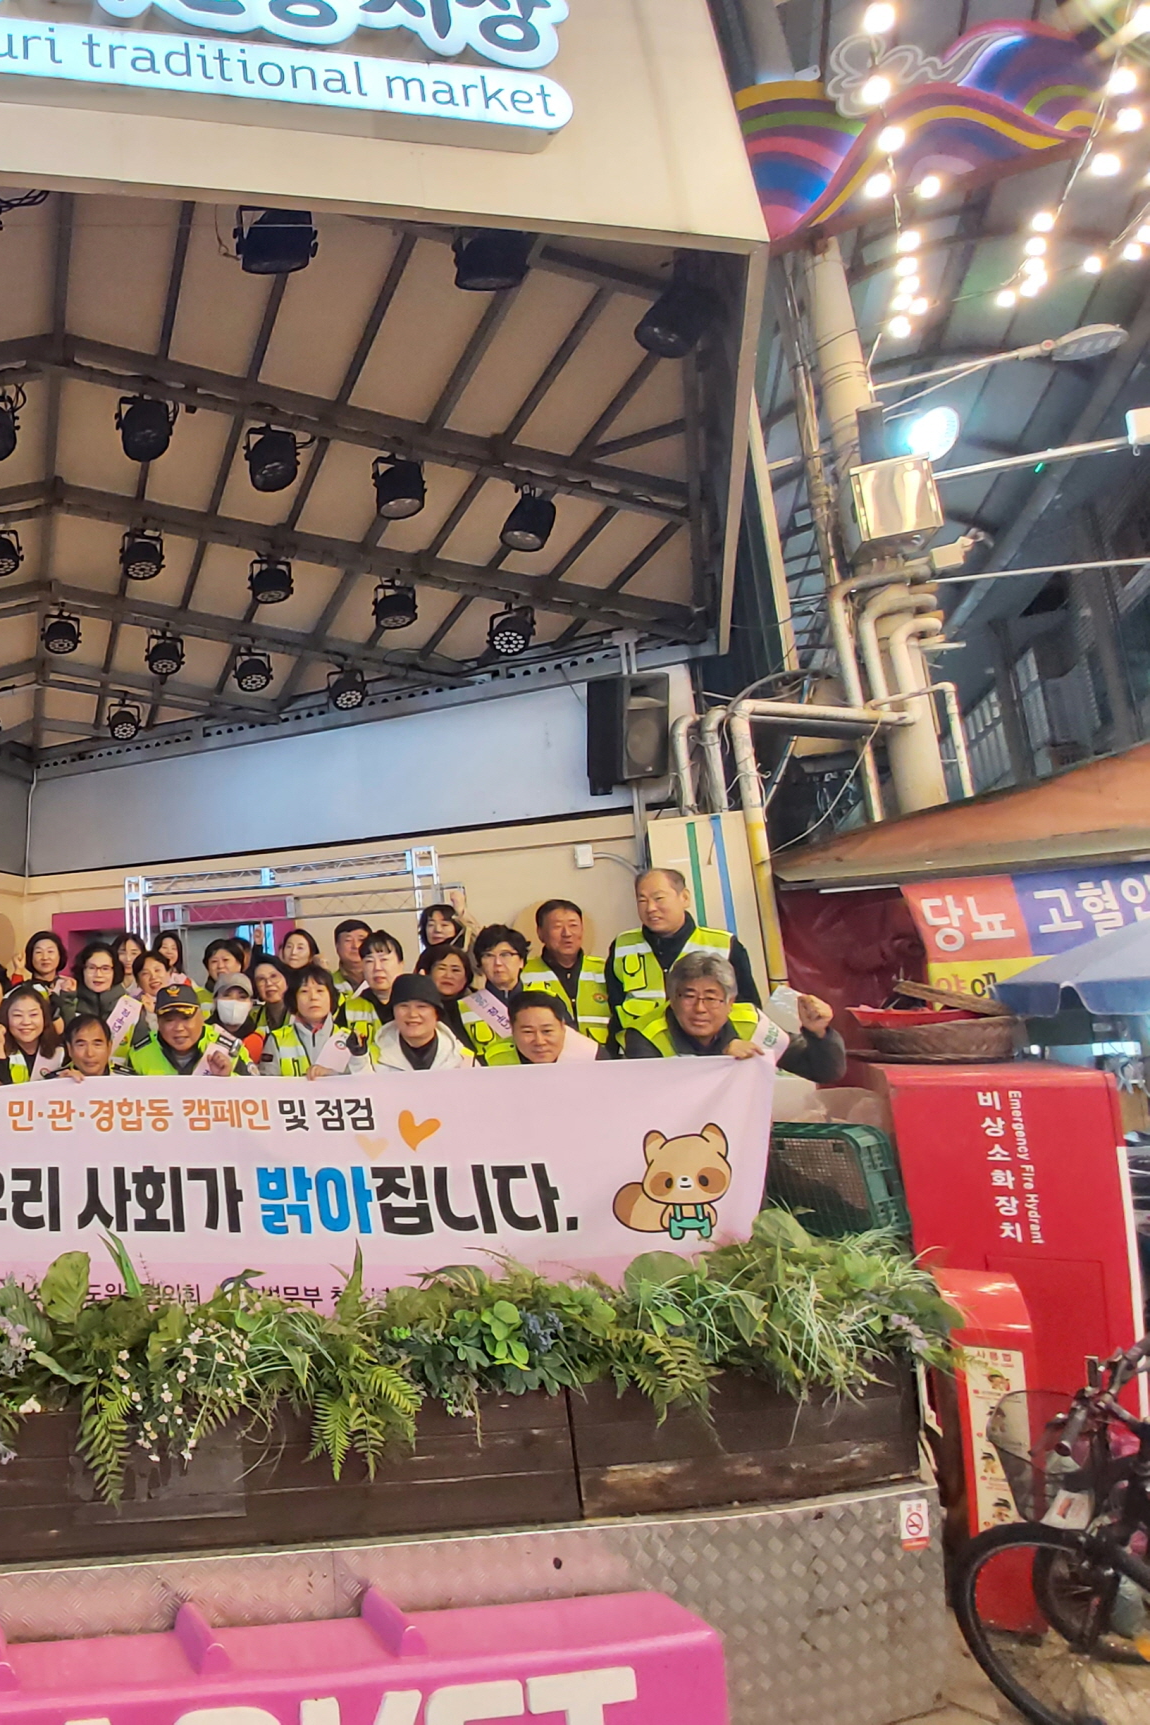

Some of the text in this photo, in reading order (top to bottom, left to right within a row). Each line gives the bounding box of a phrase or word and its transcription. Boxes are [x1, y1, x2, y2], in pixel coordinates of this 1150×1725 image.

[81, 33, 368, 97] traditional
[385, 75, 556, 117] market
[921, 894, 1016, 952] 당뇨
[182, 1097, 271, 1132] 캠페인
[277, 1097, 309, 1132] 및
[314, 1096, 375, 1132] 점검
[77, 1164, 243, 1233] 사회가
[257, 1163, 579, 1235] 밝아집니다.
[976, 1090, 1023, 1243] 비상소화장치
[1007, 1090, 1046, 1244] Emergency Fire Hydrant
